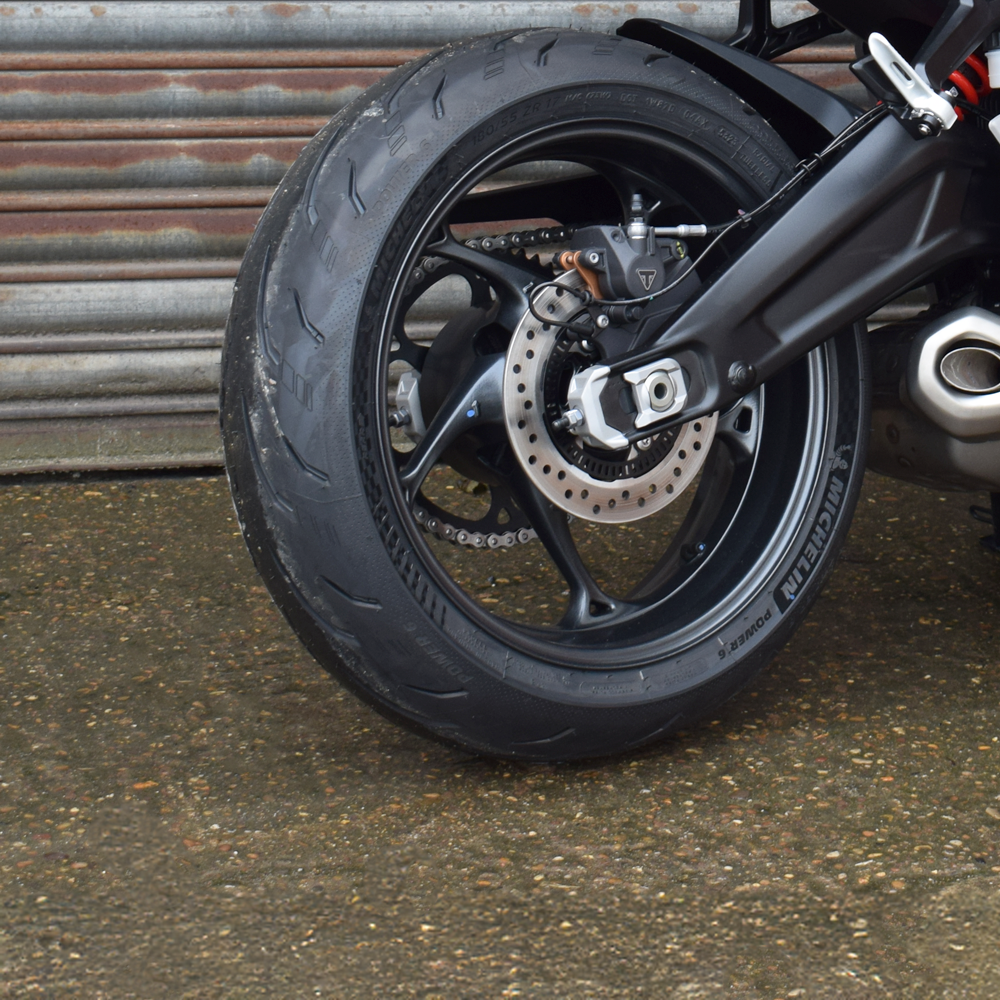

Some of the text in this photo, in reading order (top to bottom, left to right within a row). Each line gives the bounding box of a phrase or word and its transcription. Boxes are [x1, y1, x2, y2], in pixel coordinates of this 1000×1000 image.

[473, 113, 517, 145] 180/55
[523, 102, 541, 117] ZR
[547, 96, 562, 109] 17
[780, 475, 845, 601] MICHELIN
[415, 635, 475, 684] POWER
[717, 608, 773, 661] POWER 6
